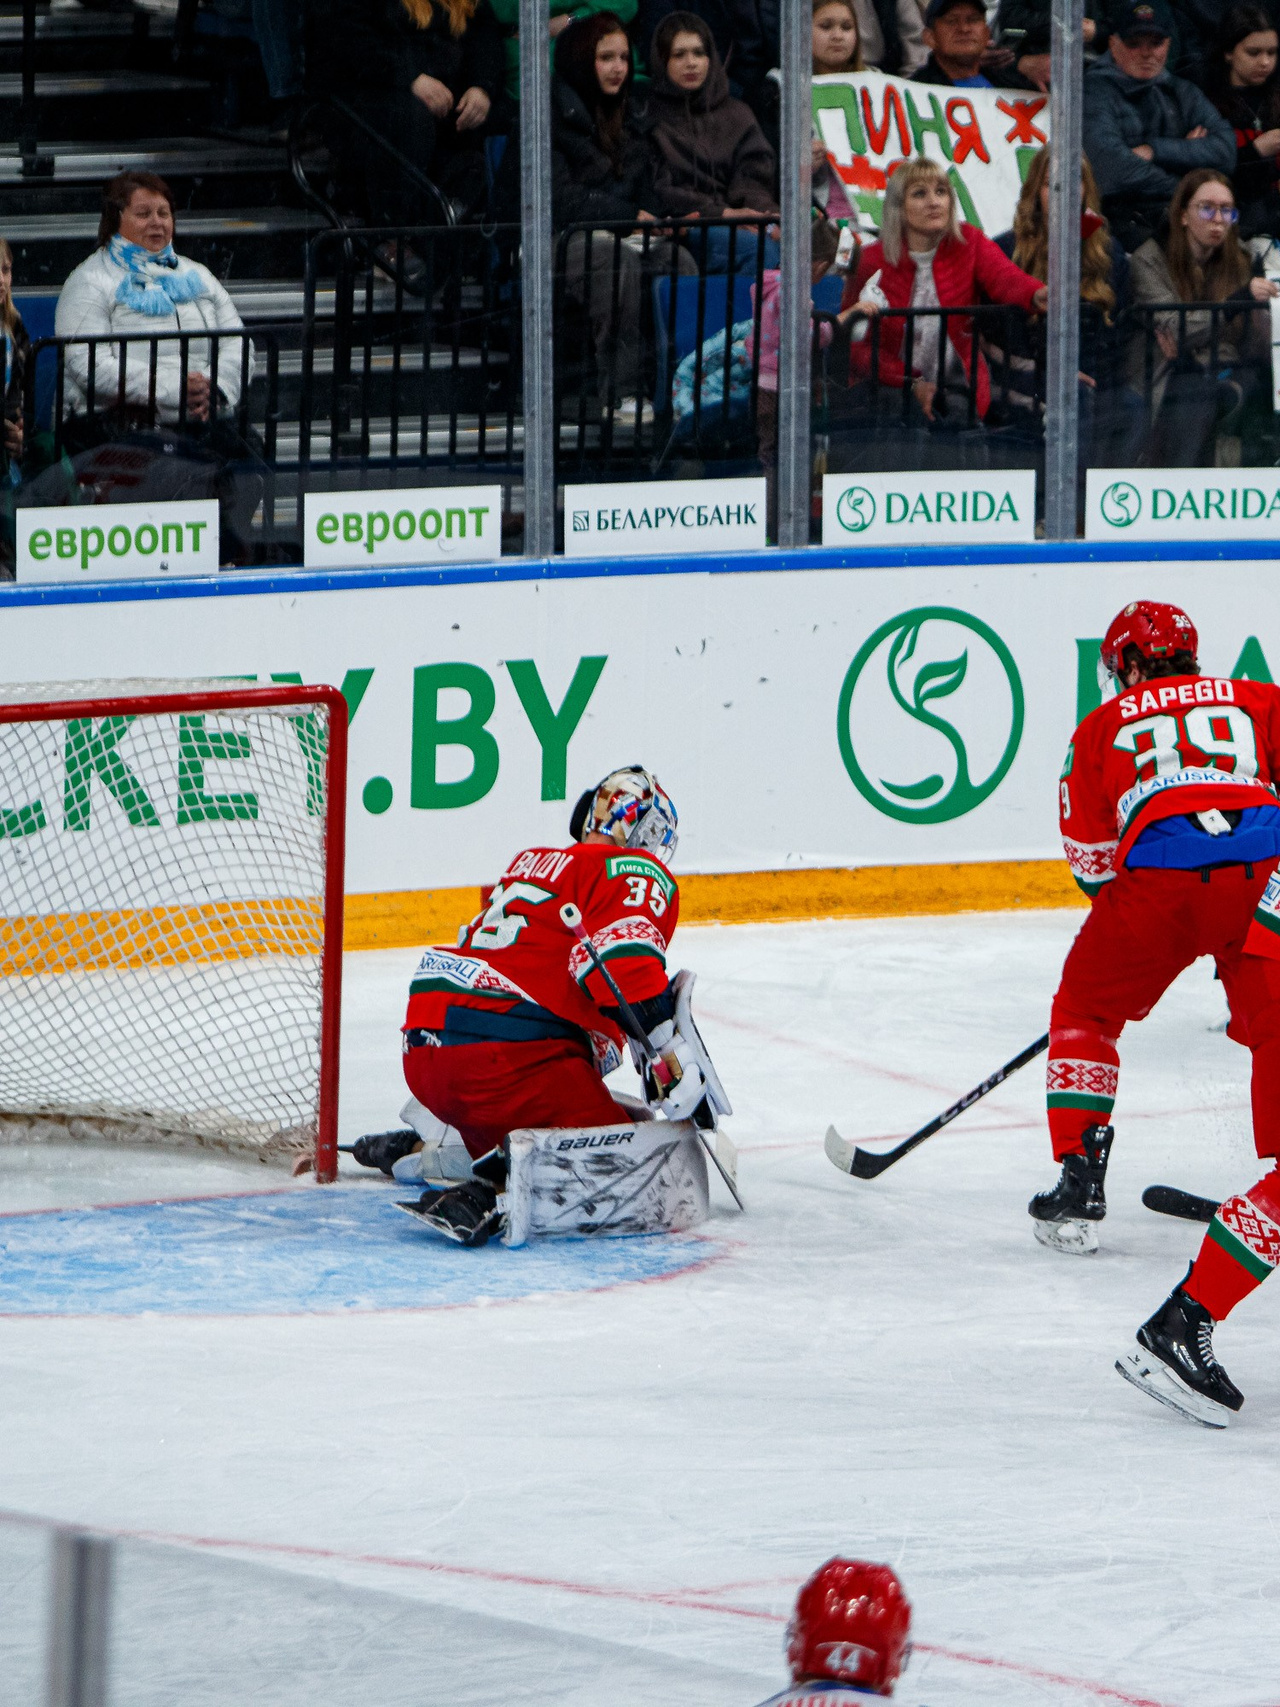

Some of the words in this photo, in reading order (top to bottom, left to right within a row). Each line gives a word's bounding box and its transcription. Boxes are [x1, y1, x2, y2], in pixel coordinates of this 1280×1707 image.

[596, 503, 758, 531] БЕЛАРУСБАНК
[885, 490, 1020, 525] DARIDA
[28, 519, 208, 568] евроопт
[316, 506, 489, 553] евроопт
[1119, 679, 1235, 719] SAPEGO
[0, 655, 608, 838] KEY.BY
[1112, 704, 1260, 787] 39
[622, 876, 667, 918] 35
[556, 1131, 636, 1151] BAUER
[825, 1648, 861, 1672] 44
